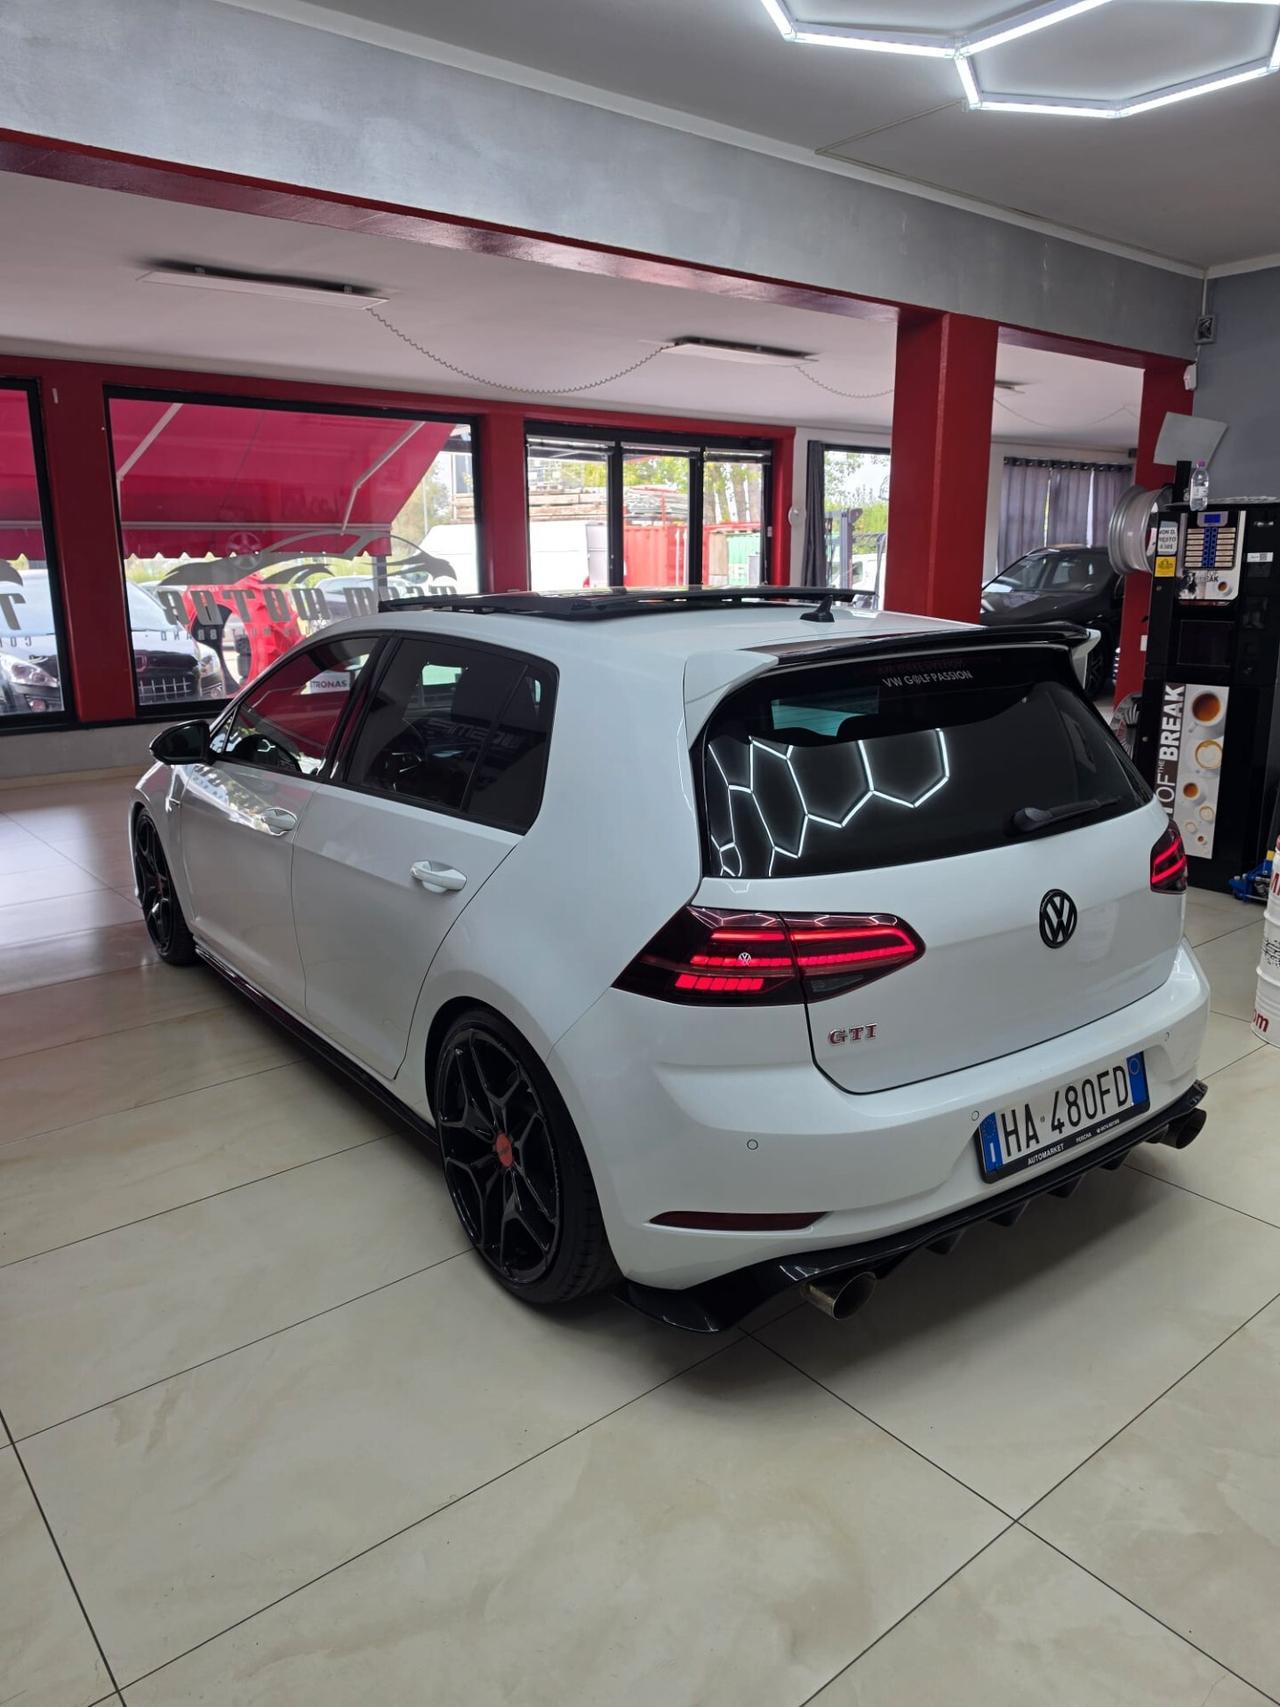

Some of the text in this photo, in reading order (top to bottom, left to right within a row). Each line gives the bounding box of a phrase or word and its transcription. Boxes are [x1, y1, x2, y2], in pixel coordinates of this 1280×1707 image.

[930, 669, 974, 682] PASSION
[1159, 683, 1186, 762] BREAK
[1156, 772, 1177, 802] OF
[827, 1022, 878, 1046] GTI
[1001, 1065, 1129, 1157] HA 480FD
[1027, 1142, 1065, 1166] AUTOMARKET
